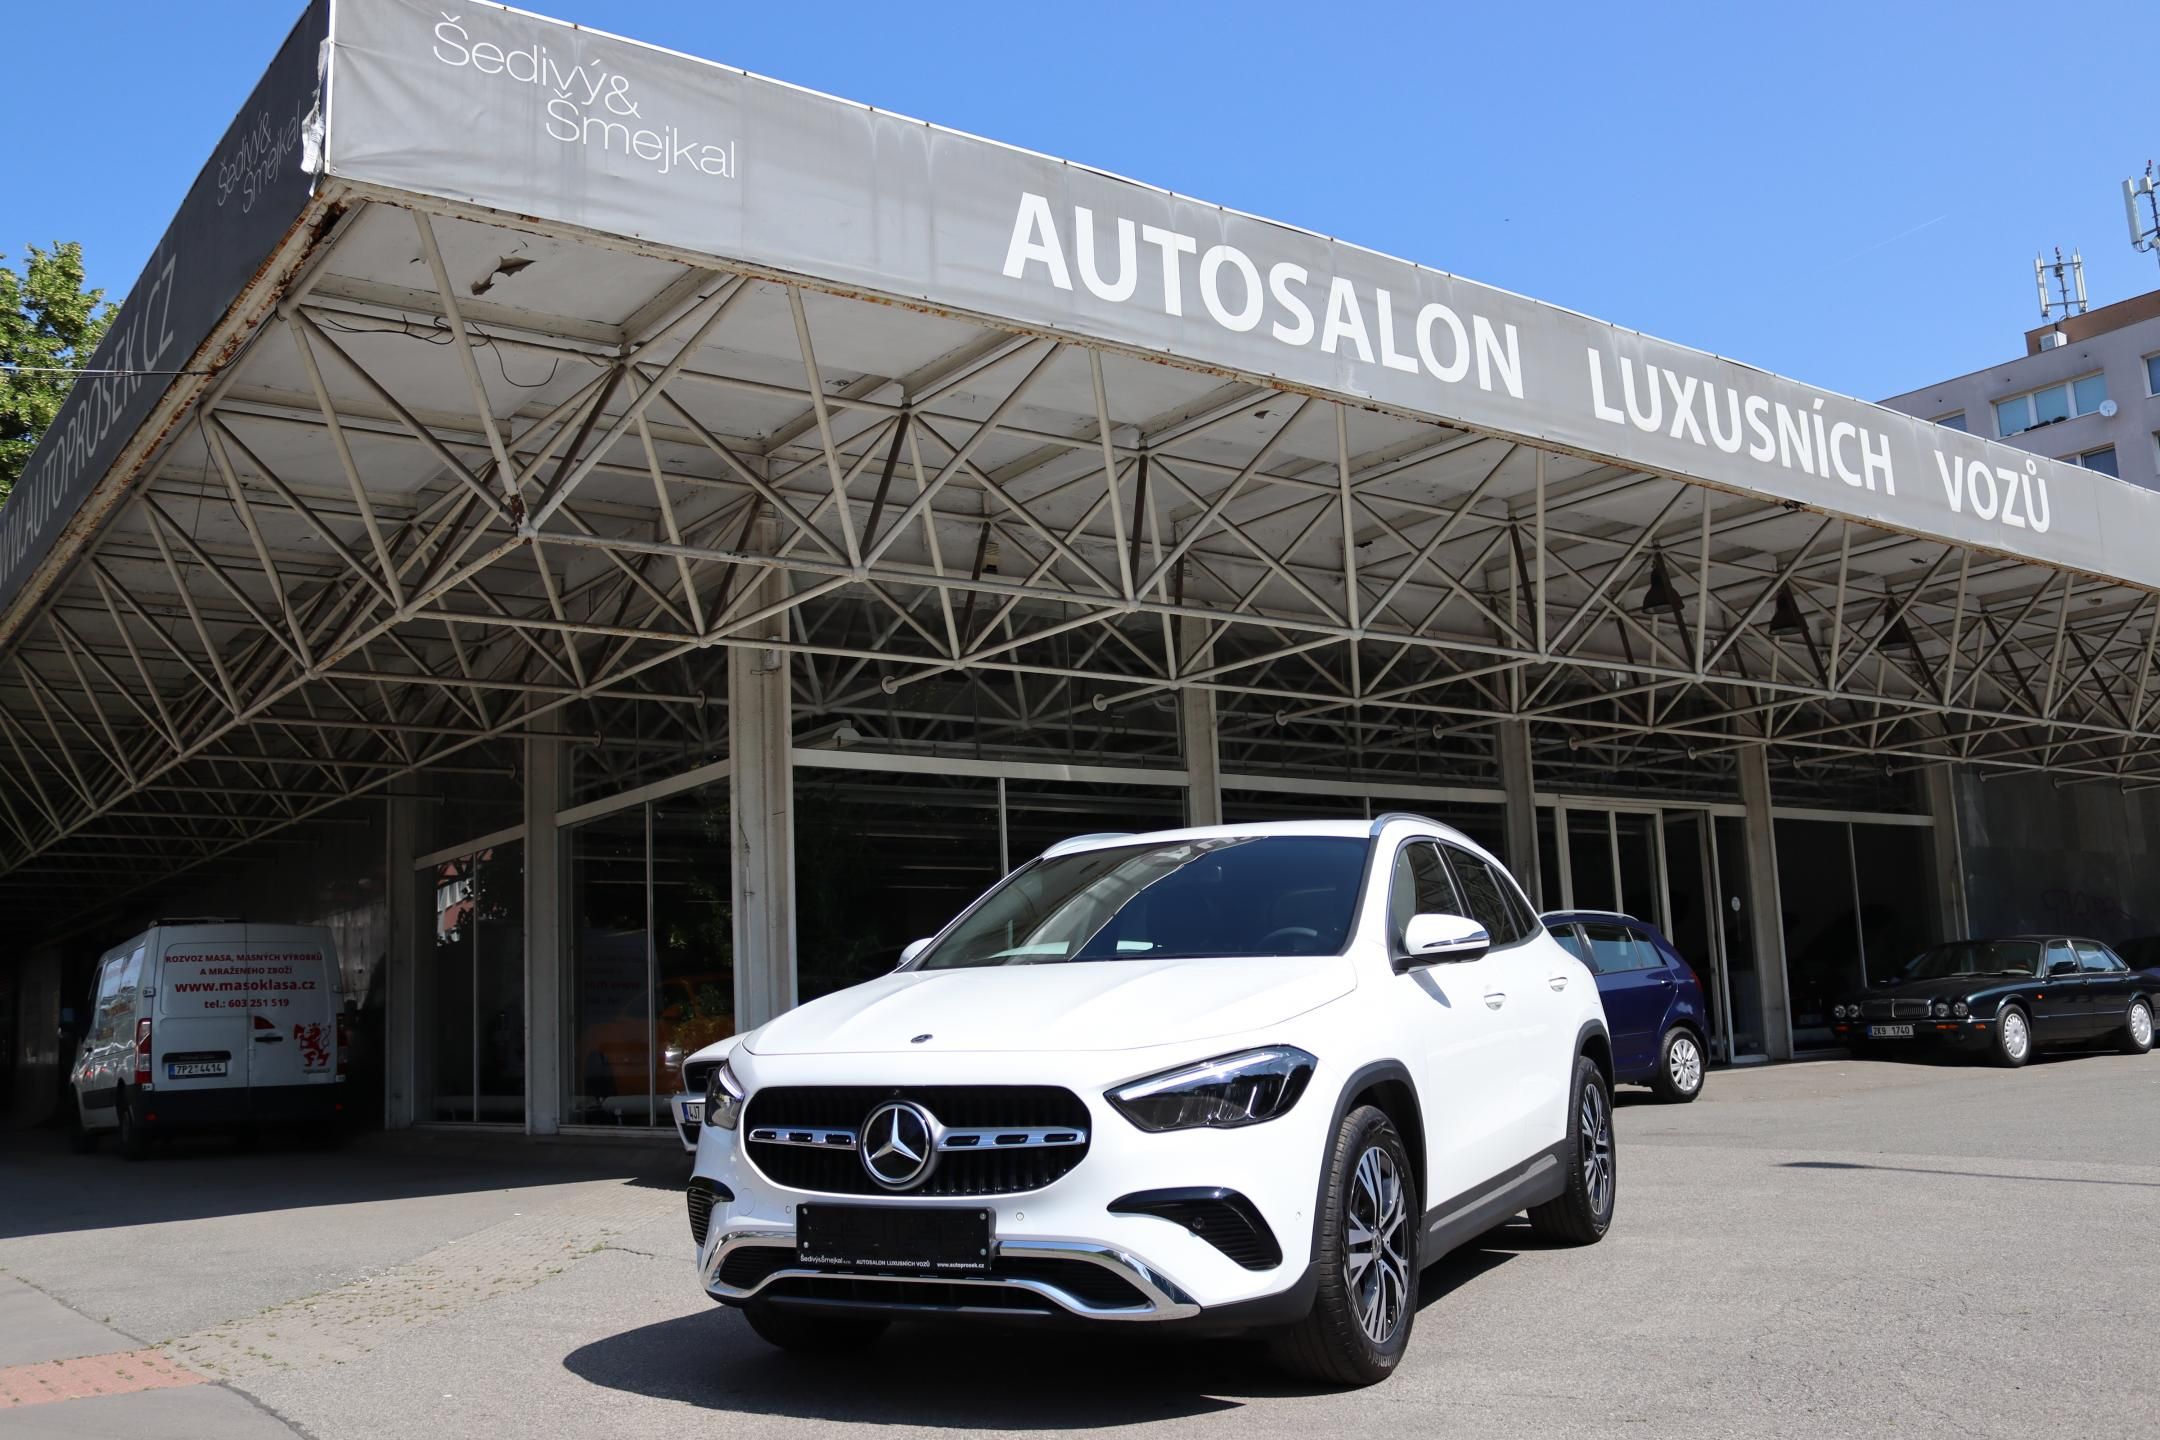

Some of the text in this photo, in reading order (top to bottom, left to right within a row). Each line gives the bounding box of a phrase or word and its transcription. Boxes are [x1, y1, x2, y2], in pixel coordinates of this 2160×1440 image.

[545, 87, 736, 179] Šmejkal
[242, 99, 301, 214] Šmejkal
[1002, 191, 2052, 534] AUTOSALON LUXUSNÍCH VOZŮ
[165, 951, 323, 964] ROZVOZ MASA, MASNÝCH VÝROBKŮ
[199, 968, 207, 976] A
[208, 966, 265, 976] MRAŽENÉHO
[175, 979, 316, 993] www.masoklasa.cz
[204, 998, 290, 1009] tel.: 603 251 519
